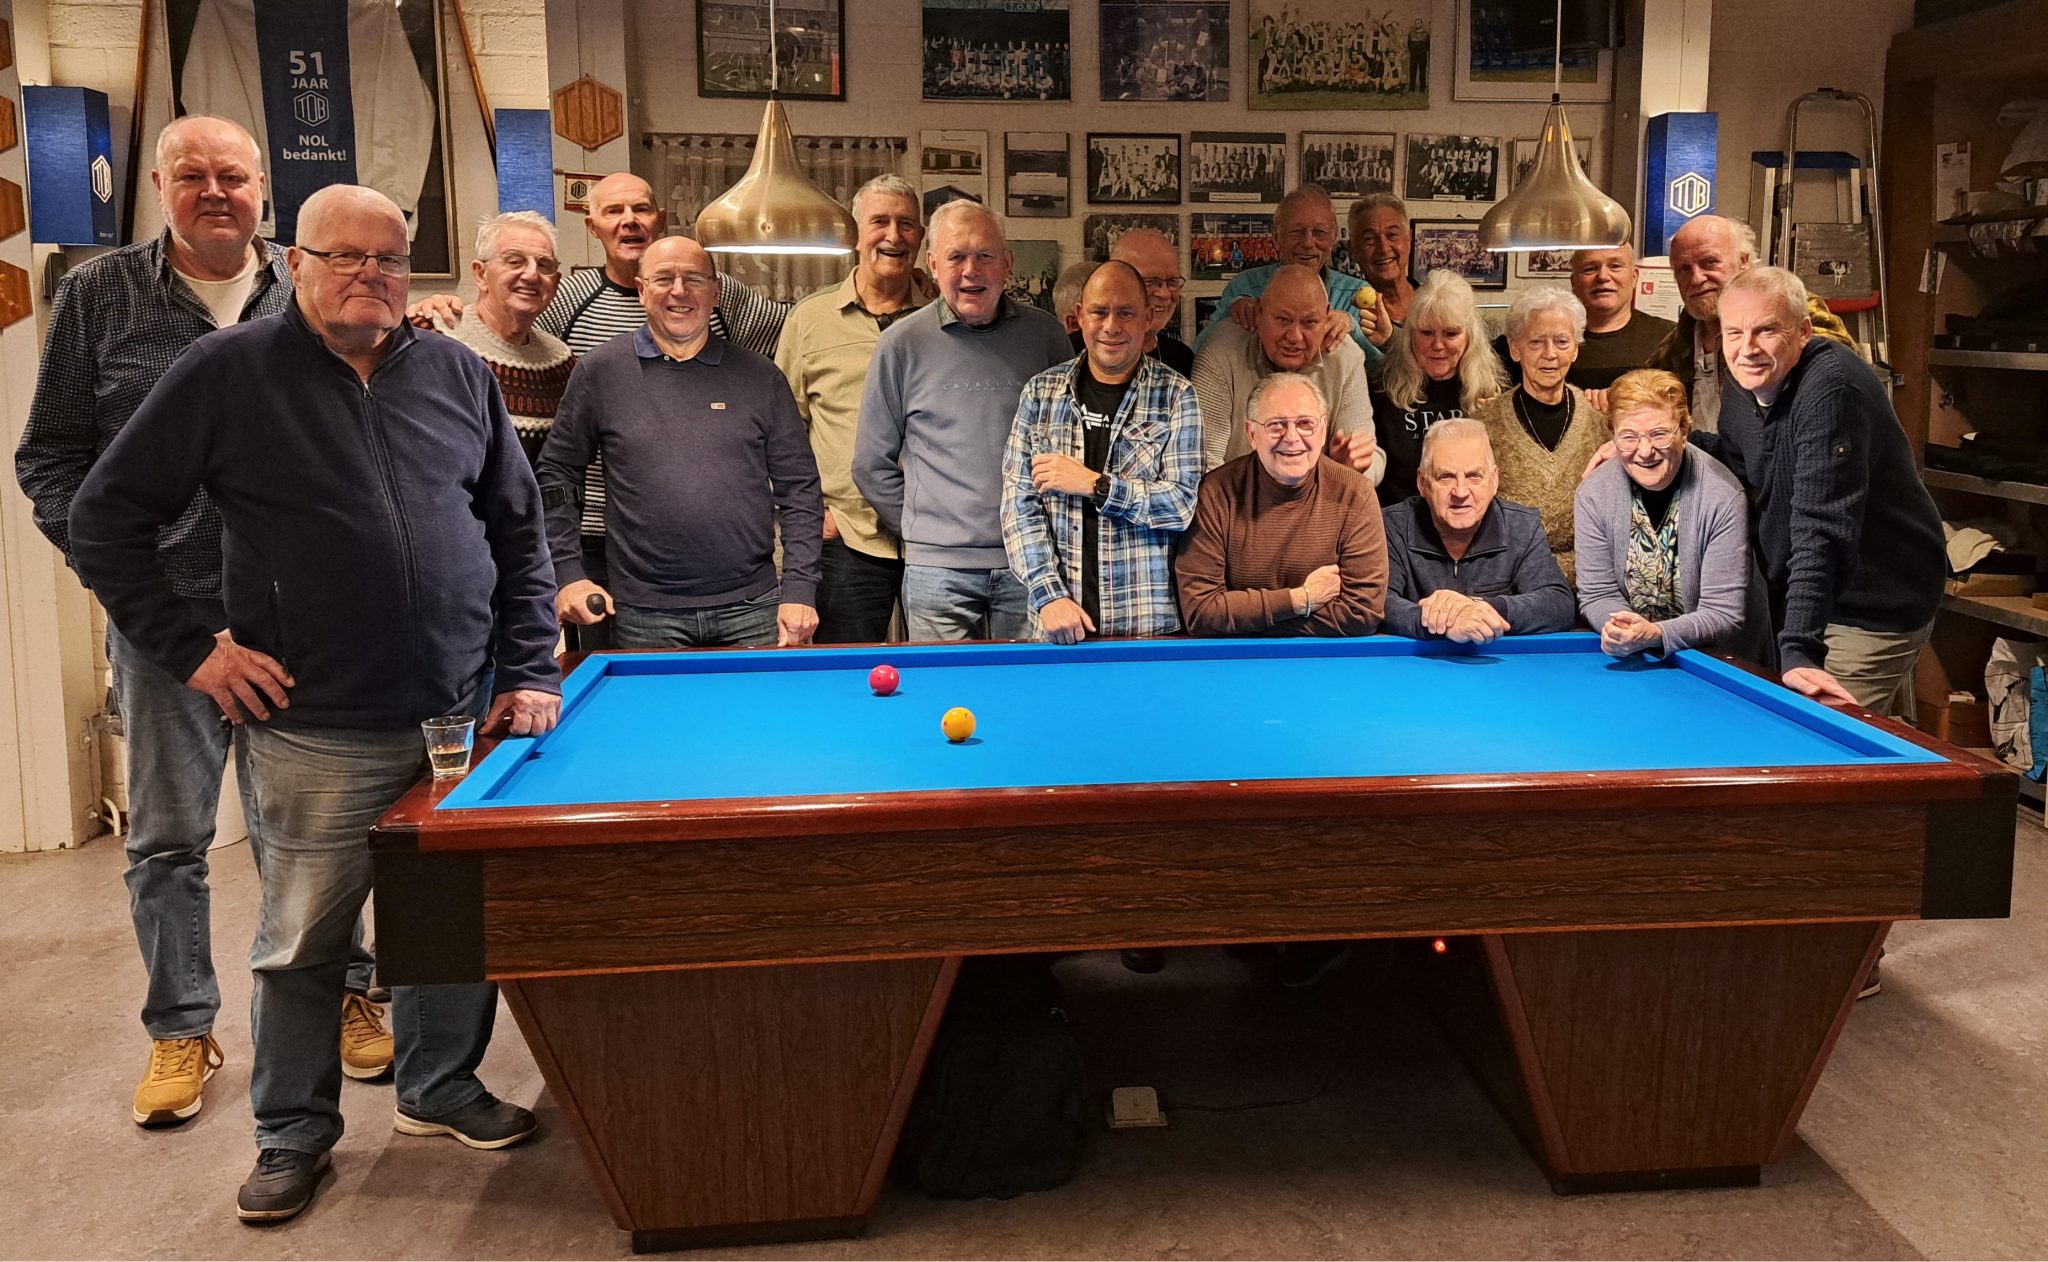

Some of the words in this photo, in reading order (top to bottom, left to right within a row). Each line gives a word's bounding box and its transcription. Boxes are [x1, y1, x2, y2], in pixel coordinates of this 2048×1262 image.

[289, 50, 324, 75] 51
[291, 77, 329, 90] JAAR
[296, 93, 327, 123] TOB
[298, 134, 329, 147] NOL
[282, 148, 347, 161] bedankt!
[93, 160, 111, 199] TOB
[1673, 176, 1706, 213] TOB
